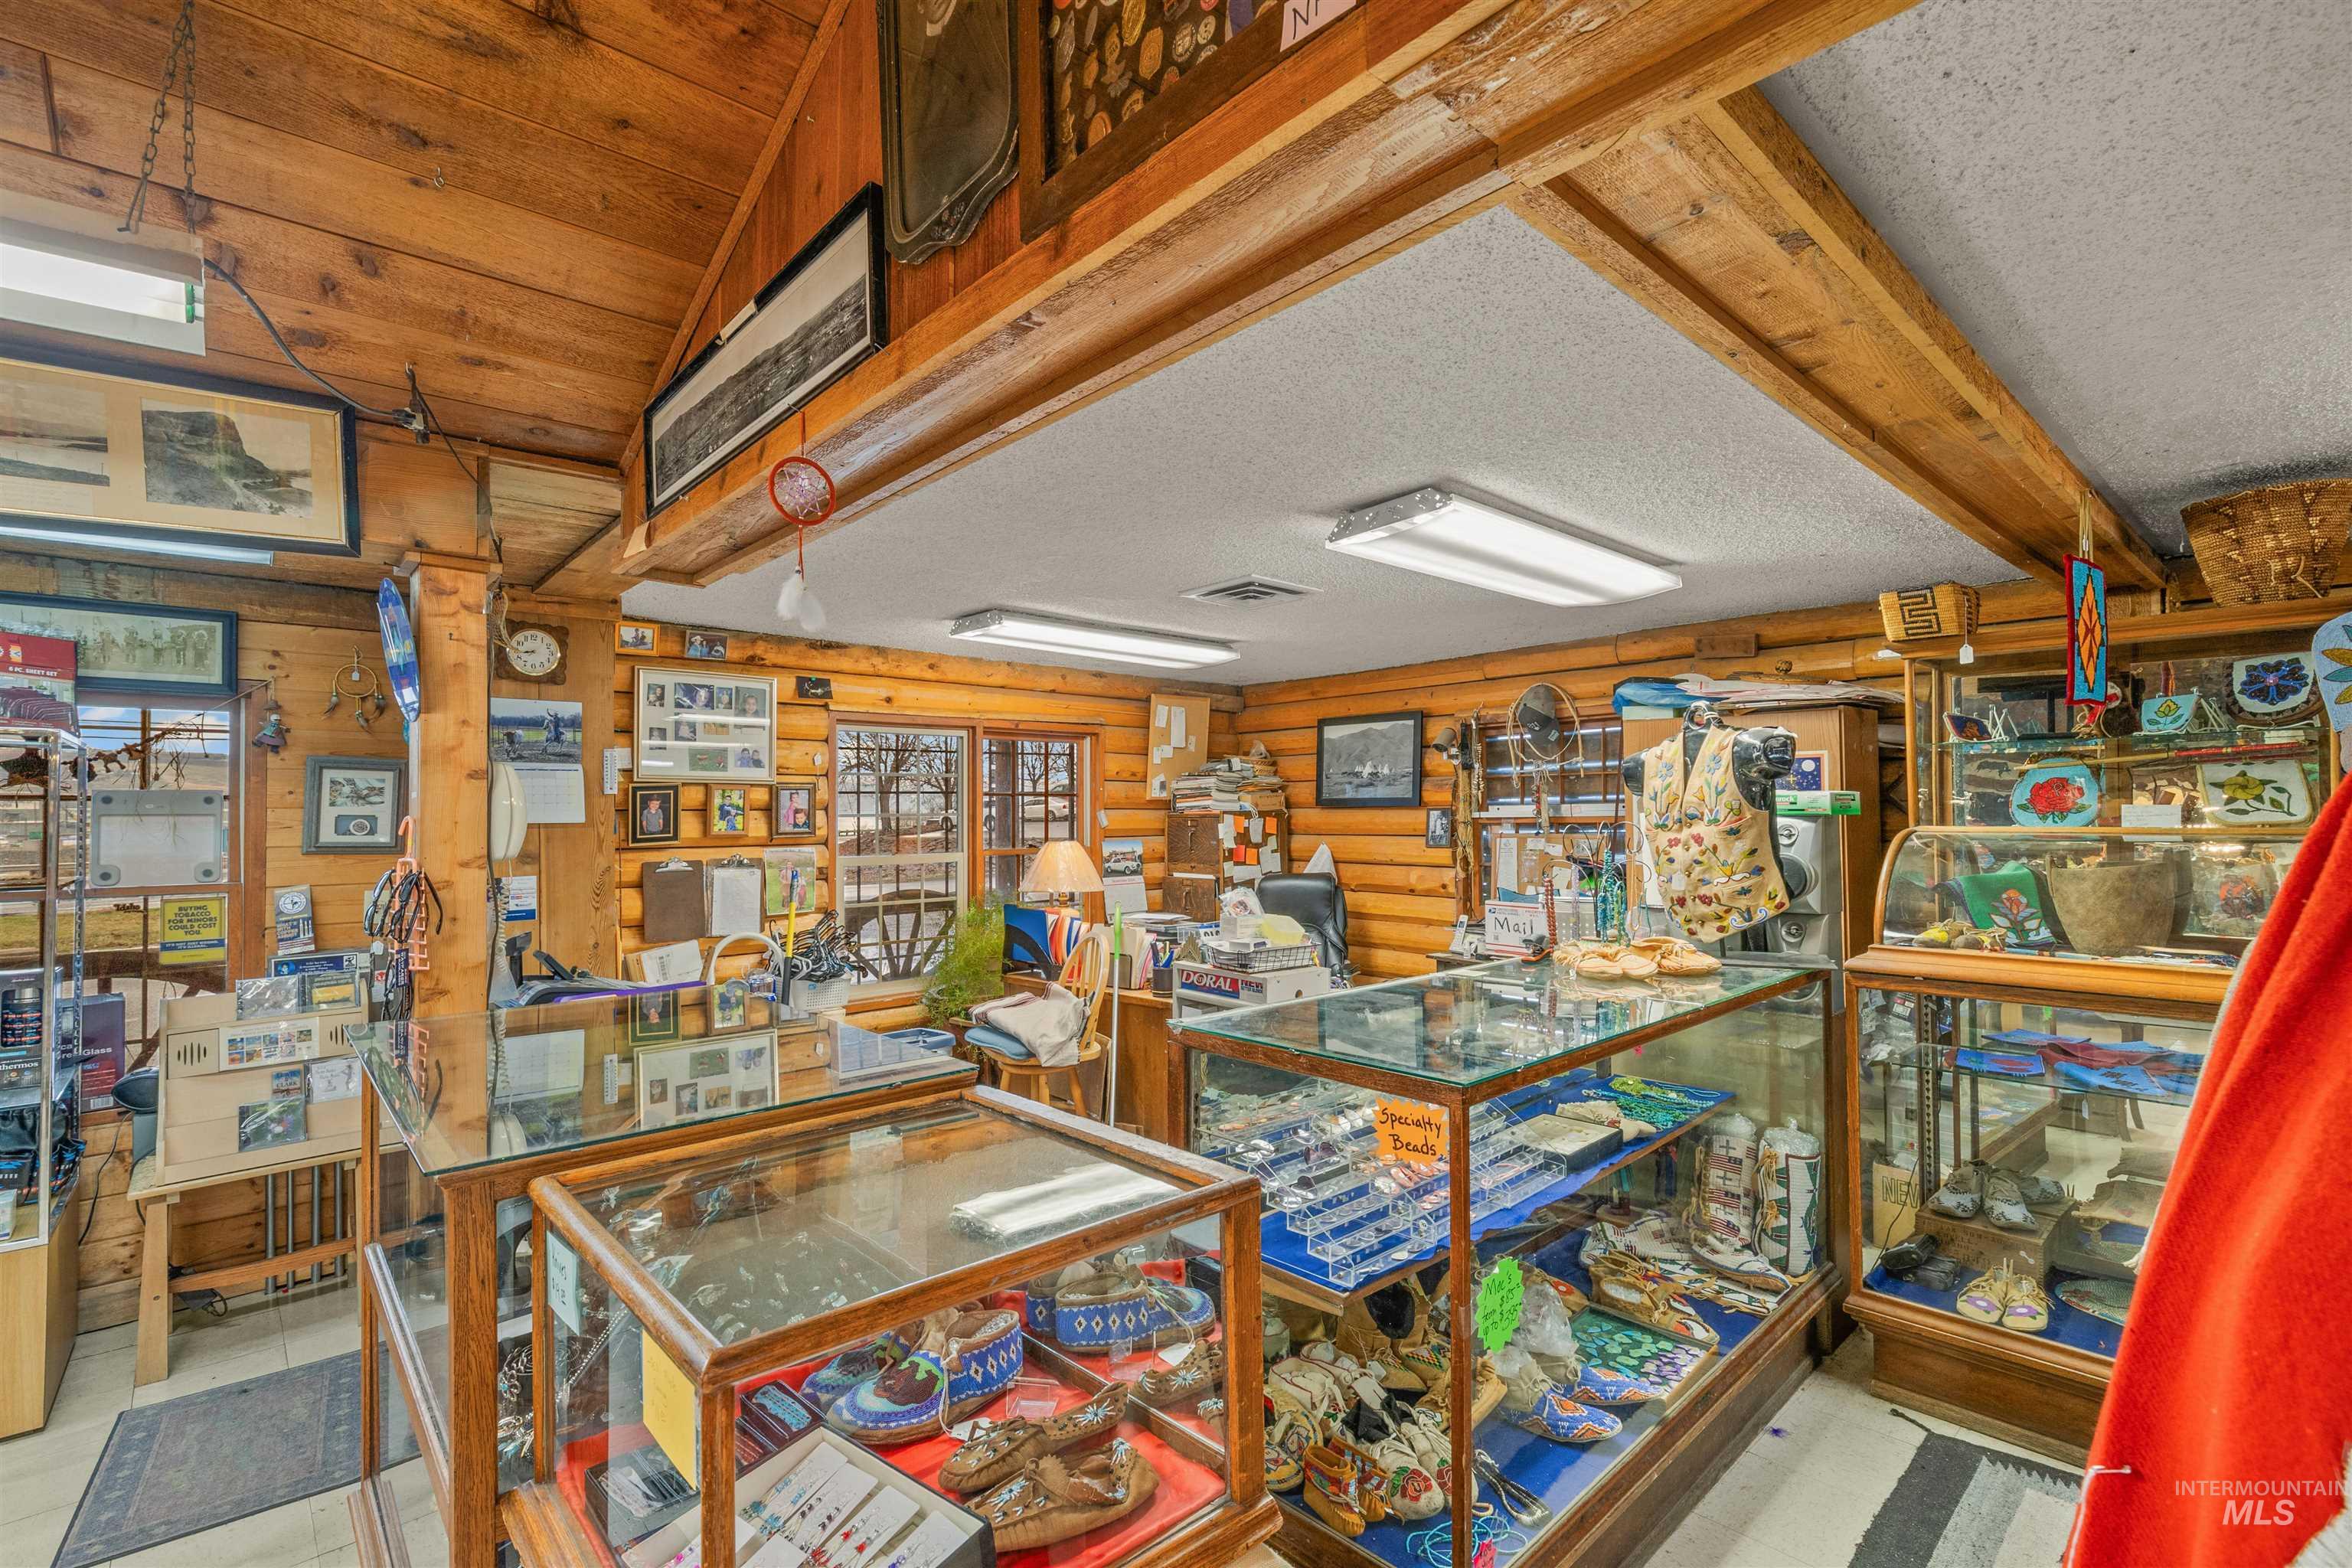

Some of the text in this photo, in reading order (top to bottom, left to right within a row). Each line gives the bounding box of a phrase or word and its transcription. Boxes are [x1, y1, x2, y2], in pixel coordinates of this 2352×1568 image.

[1494, 916, 1534, 935] Mail
[1181, 970, 1233, 991] DORAL
[82, 1047, 113, 1056] Glass
[1379, 1107, 1441, 1138] Specialty
[1388, 1134, 1436, 1156] Beads
